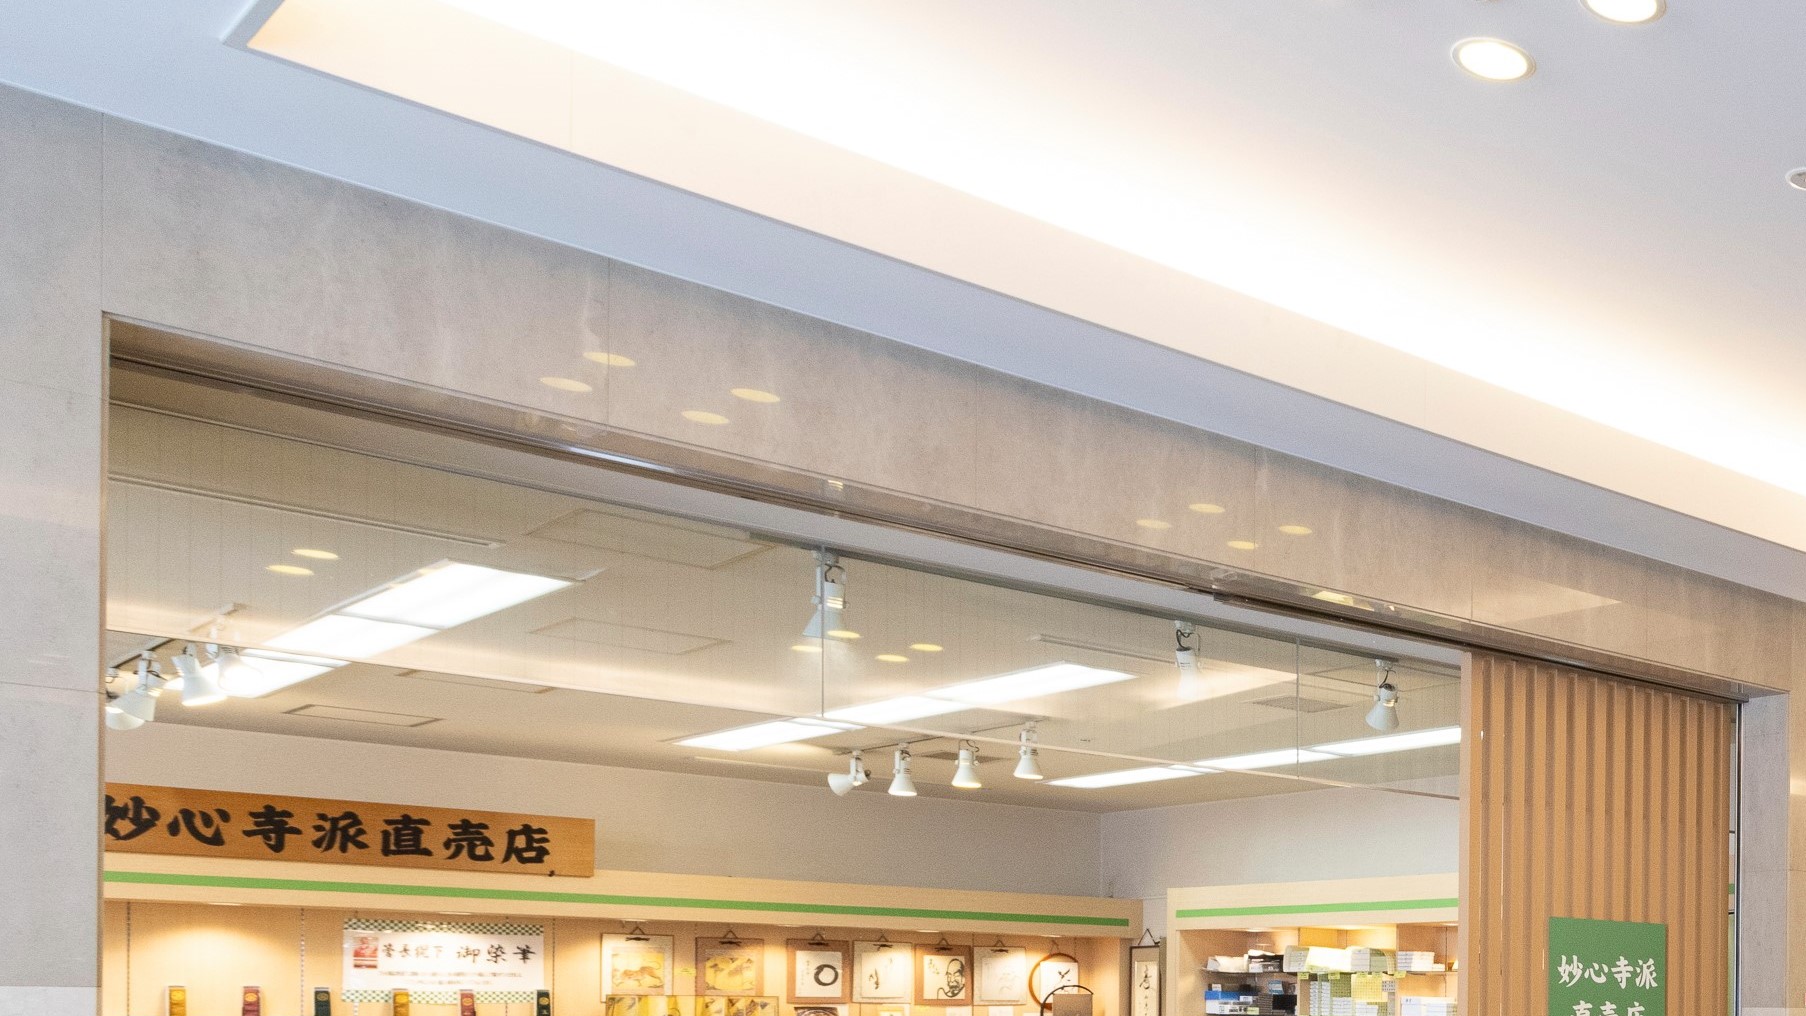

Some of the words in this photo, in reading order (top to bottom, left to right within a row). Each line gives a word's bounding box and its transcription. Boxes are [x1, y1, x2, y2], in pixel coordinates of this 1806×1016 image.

[105, 794, 551, 865] 妙心寺派直売店
[1557, 955, 1658, 990] 妙心寺派
